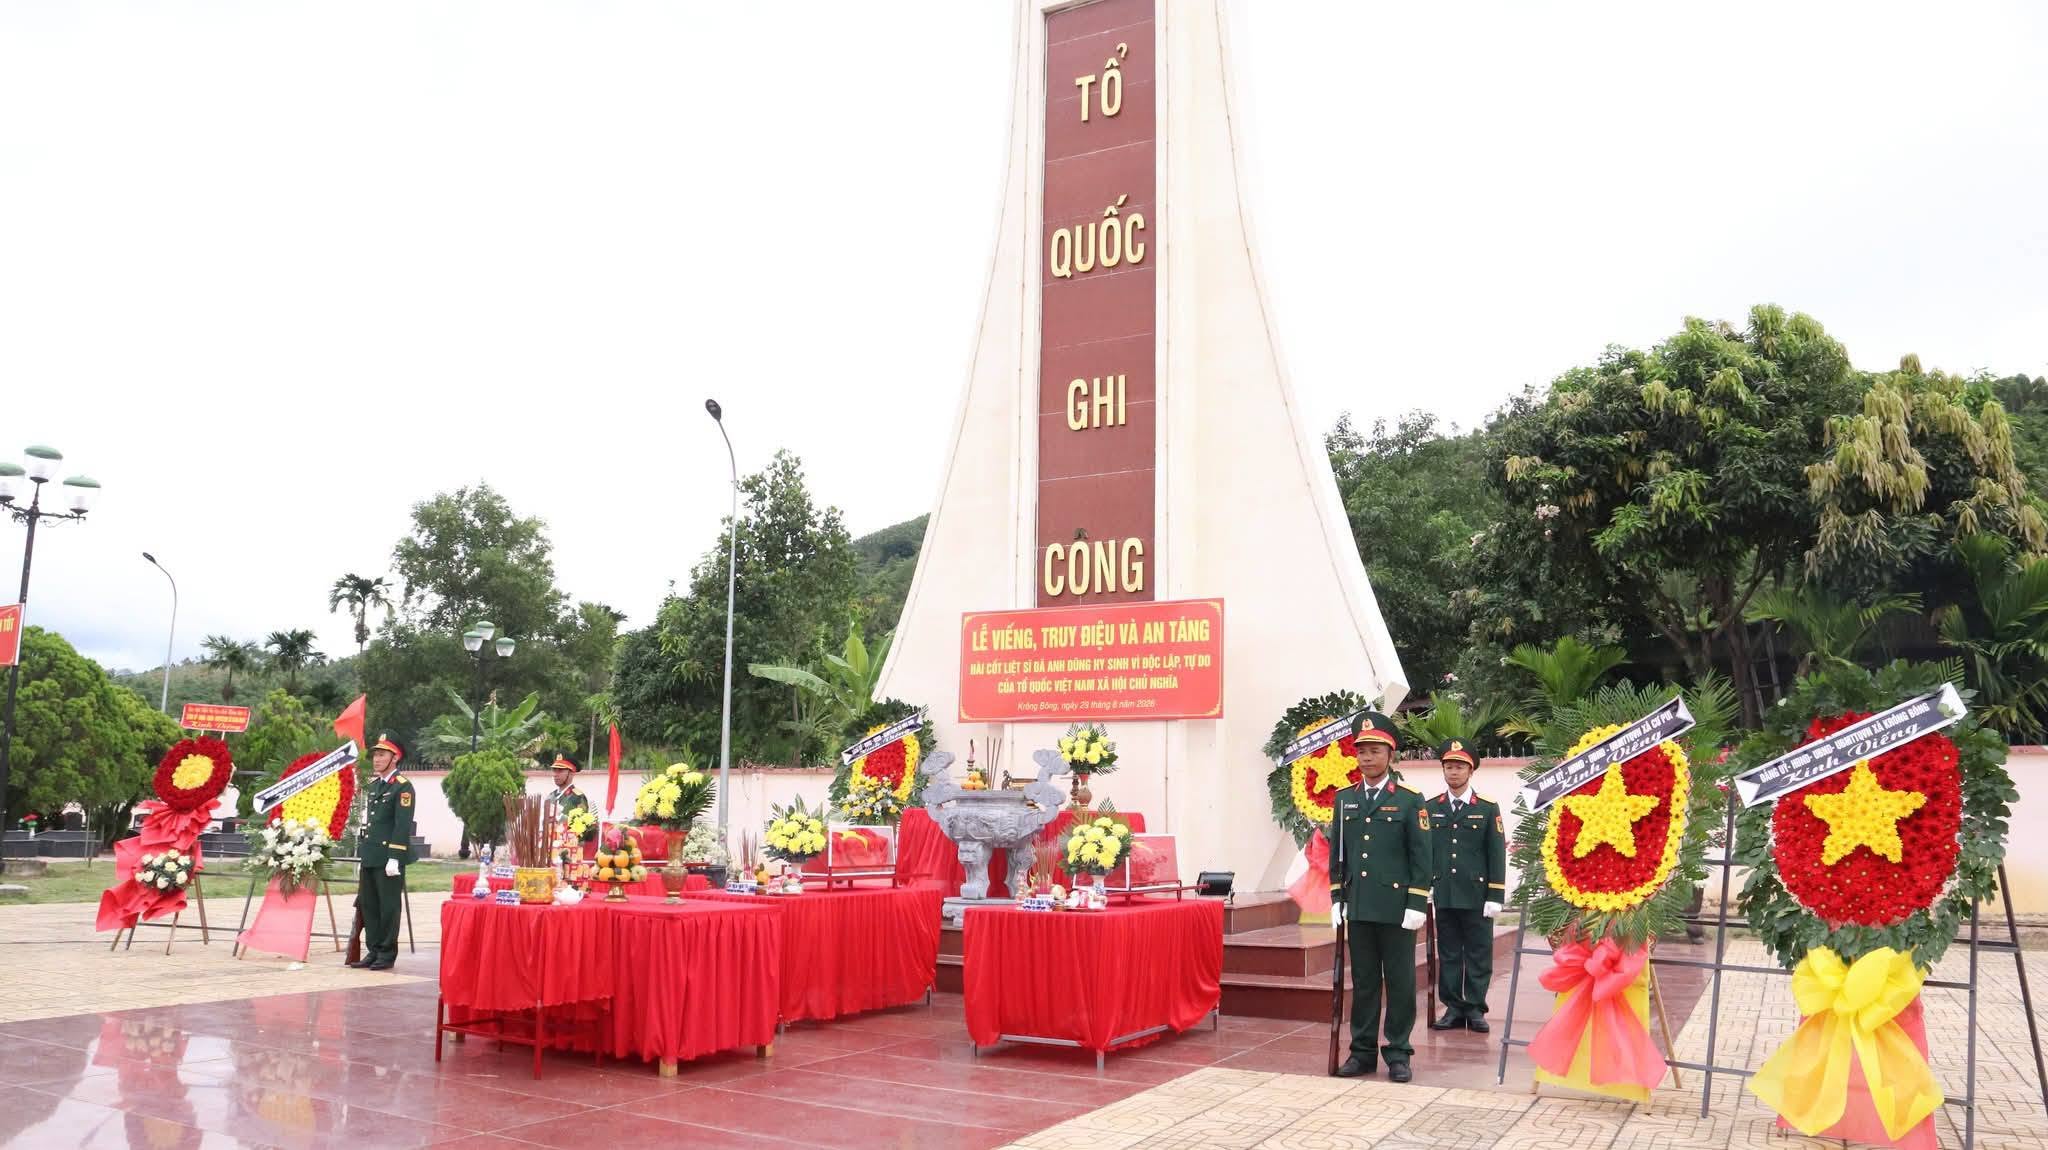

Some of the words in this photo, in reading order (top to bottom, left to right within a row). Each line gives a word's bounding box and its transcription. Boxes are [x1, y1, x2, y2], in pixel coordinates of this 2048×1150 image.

[1075, 42, 1128, 122] TỔ
[1050, 193, 1145, 279] QUỐC
[1066, 374, 1126, 431] GHI
[1044, 528, 1144, 597] CÔNG
[971, 623, 988, 652] LỄ
[992, 622, 1037, 651] VIẾNG,
[1041, 626, 1077, 648] TRUY
[1080, 619, 1115, 651] ĐIỆU
[1119, 618, 1138, 645] VÀ
[1142, 621, 1164, 644] AN
[1169, 616, 1210, 642] TÁNG
[998, 678, 1015, 694] CỦA
[1029, 675, 1052, 694] QUỐC
[1054, 677, 1072, 695] VIỆT
[1074, 678, 1095, 691] NAM
[1097, 676, 1109, 691] XÃ
[1111, 675, 1127, 693] HỘI
[1129, 673, 1148, 690] CHỦ
[1149, 674, 1178, 689] NGHĨA
[1004, 659, 1021, 676] LIỆT
[1047, 659, 1065, 673] ANH
[1067, 657, 1091, 672] DŨNG
[1093, 658, 1105, 671] HY
[1107, 657, 1129, 670] SINH
[1131, 654, 1140, 670] VÌ
[1142, 654, 1161, 671] ĐỘC
[1184, 654, 1197, 671] TỰ
[1198, 655, 1211, 667] DO
[1847, 723, 1920, 757] Viếng
